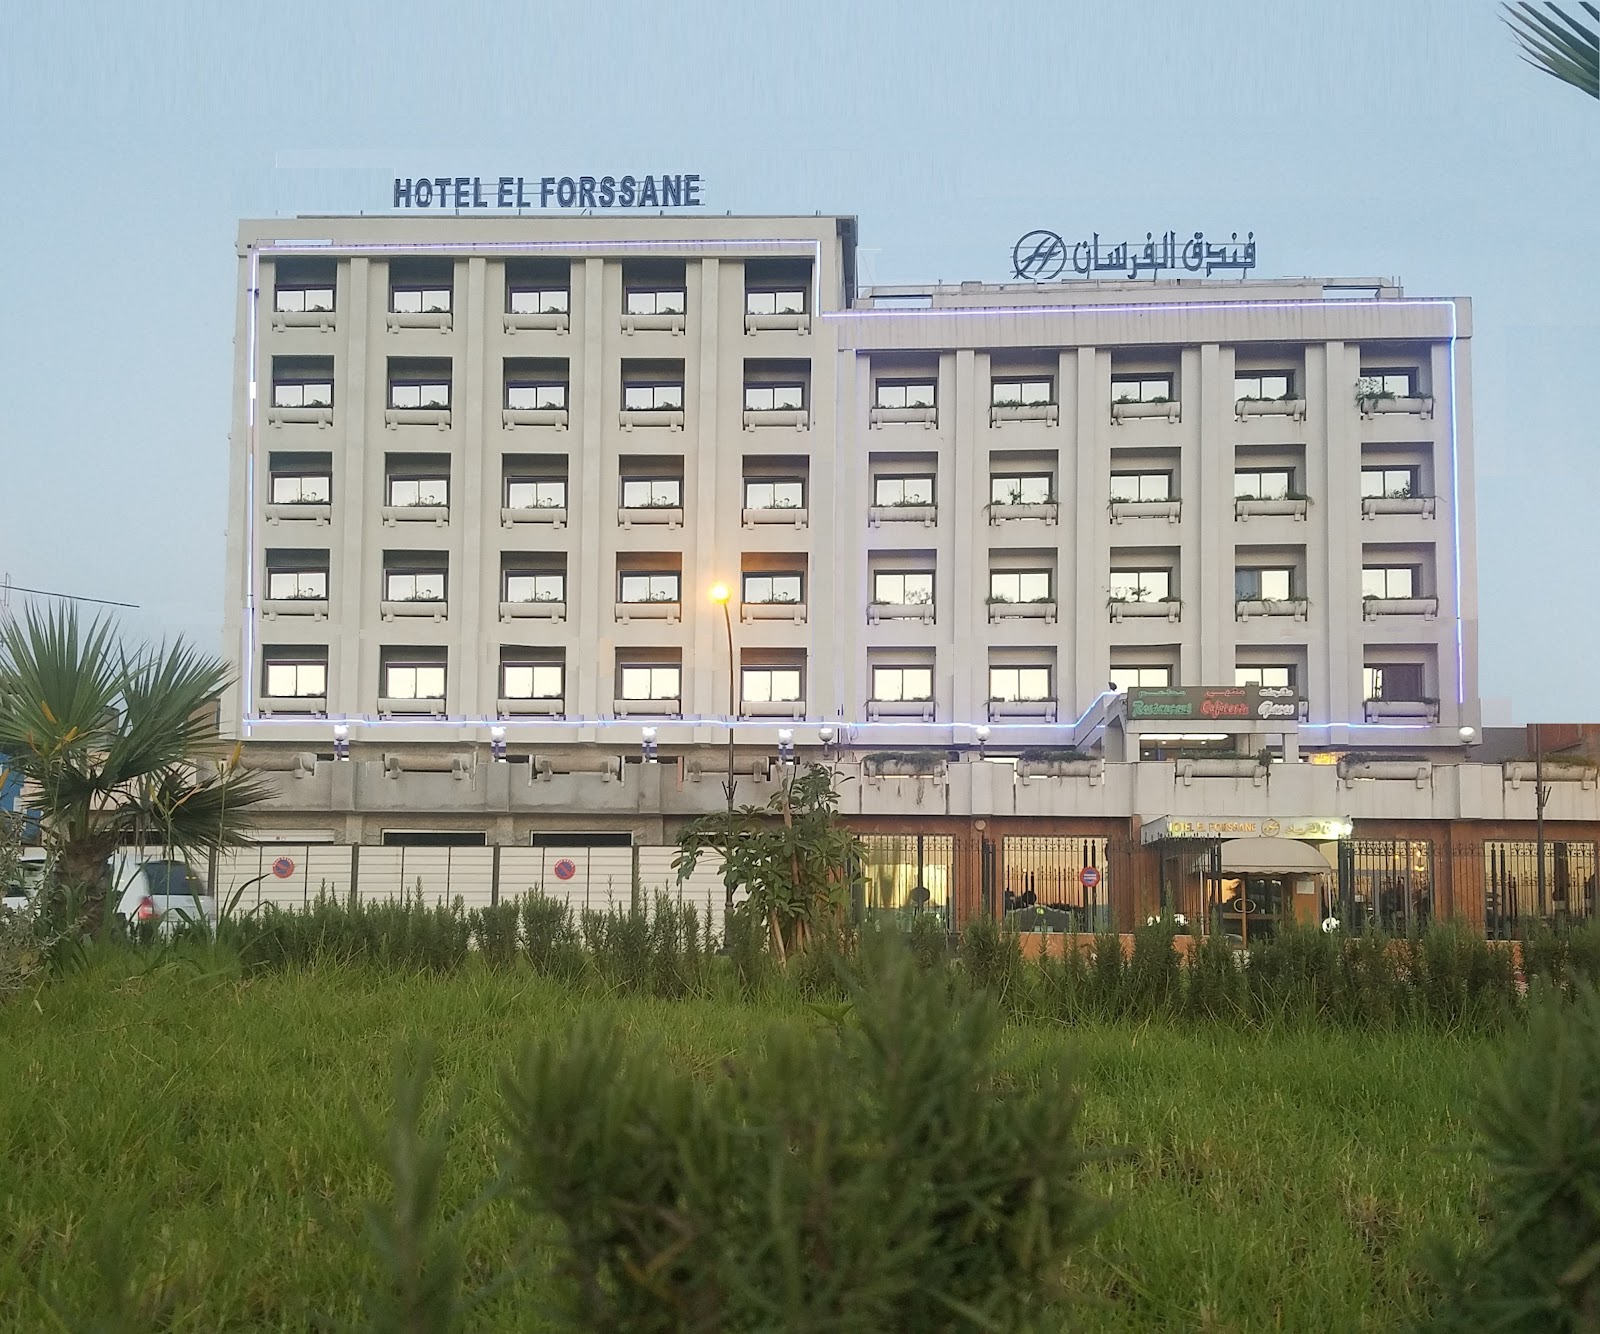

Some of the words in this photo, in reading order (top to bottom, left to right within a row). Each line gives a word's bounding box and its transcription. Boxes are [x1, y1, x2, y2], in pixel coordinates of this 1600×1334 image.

[393, 177, 488, 208] HOTEL
[498, 176, 531, 208] EL
[540, 174, 700, 208] FORSSANE
[1072, 230, 1176, 280] الفرسان
[1182, 231, 1256, 278] فندق
